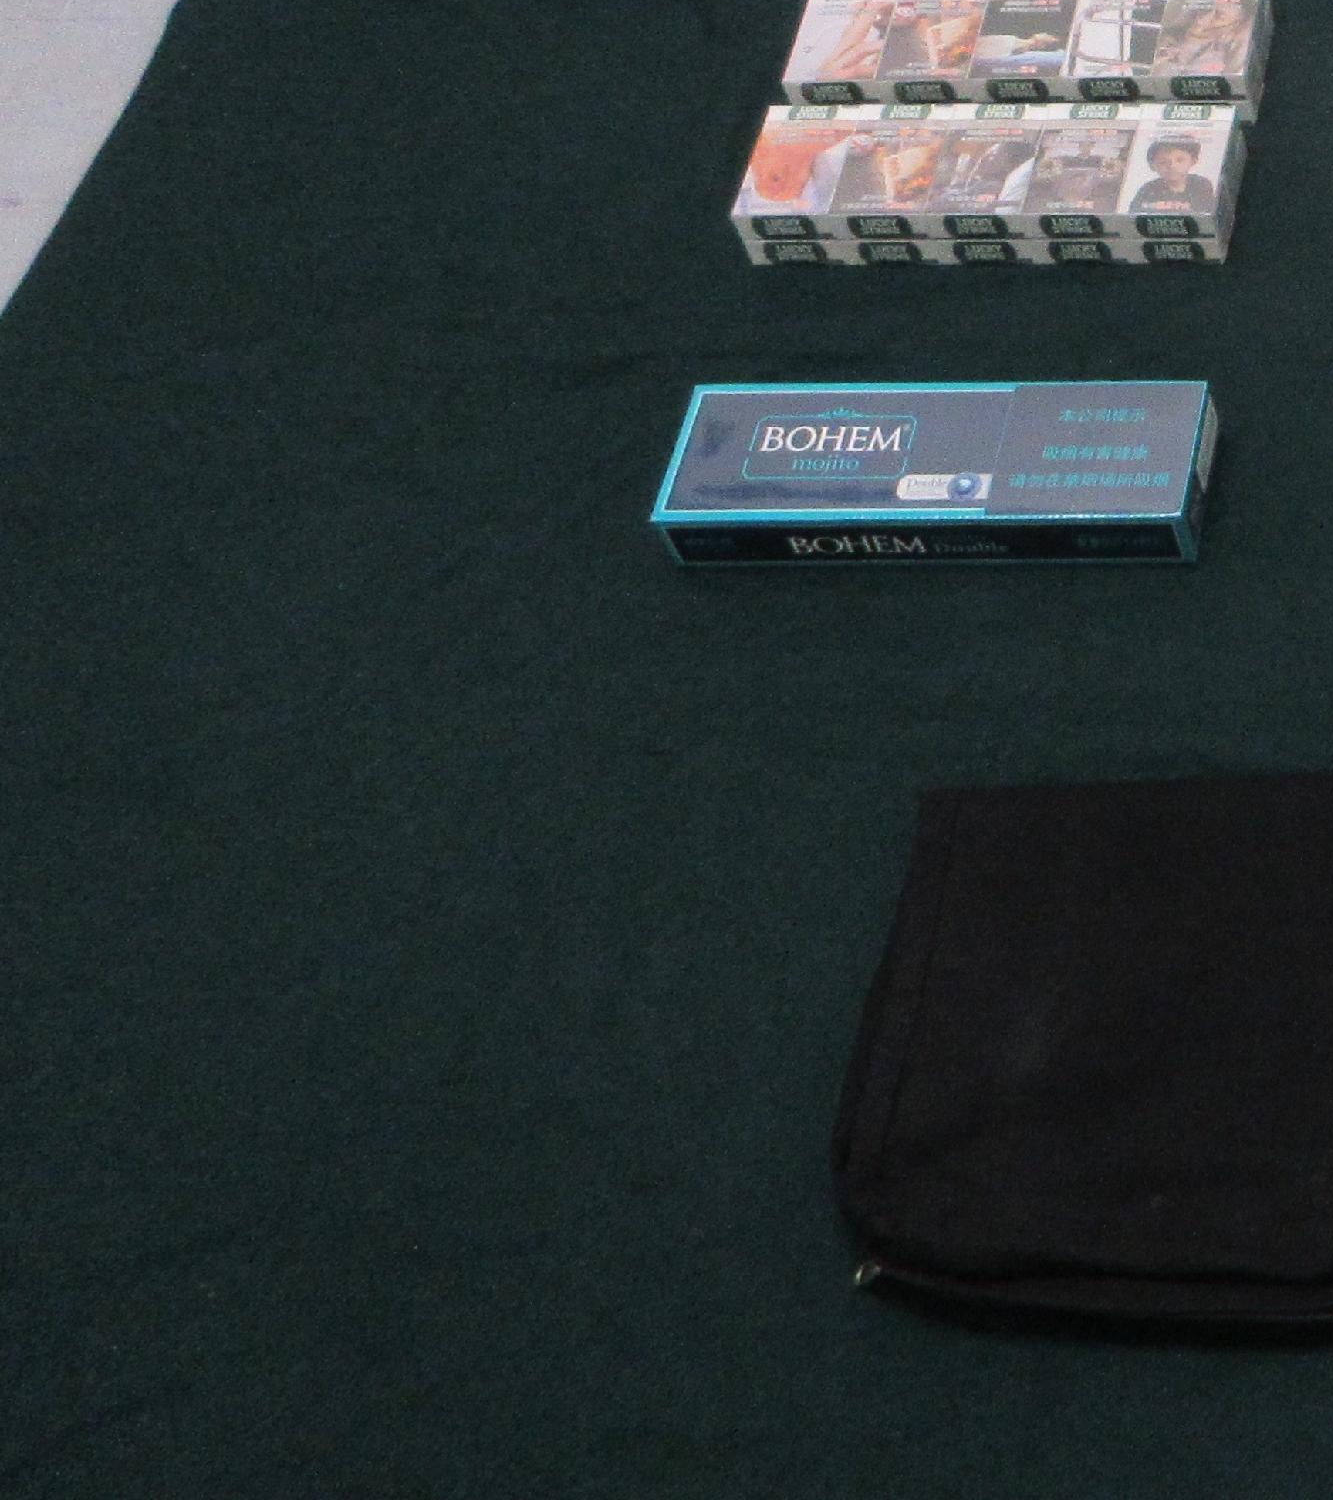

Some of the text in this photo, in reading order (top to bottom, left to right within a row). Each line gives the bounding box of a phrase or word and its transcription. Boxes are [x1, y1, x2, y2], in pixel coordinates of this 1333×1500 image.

[760, 426, 902, 452] BOHEM
[791, 454, 860, 474] mojito
[787, 534, 928, 555] BOHEM
